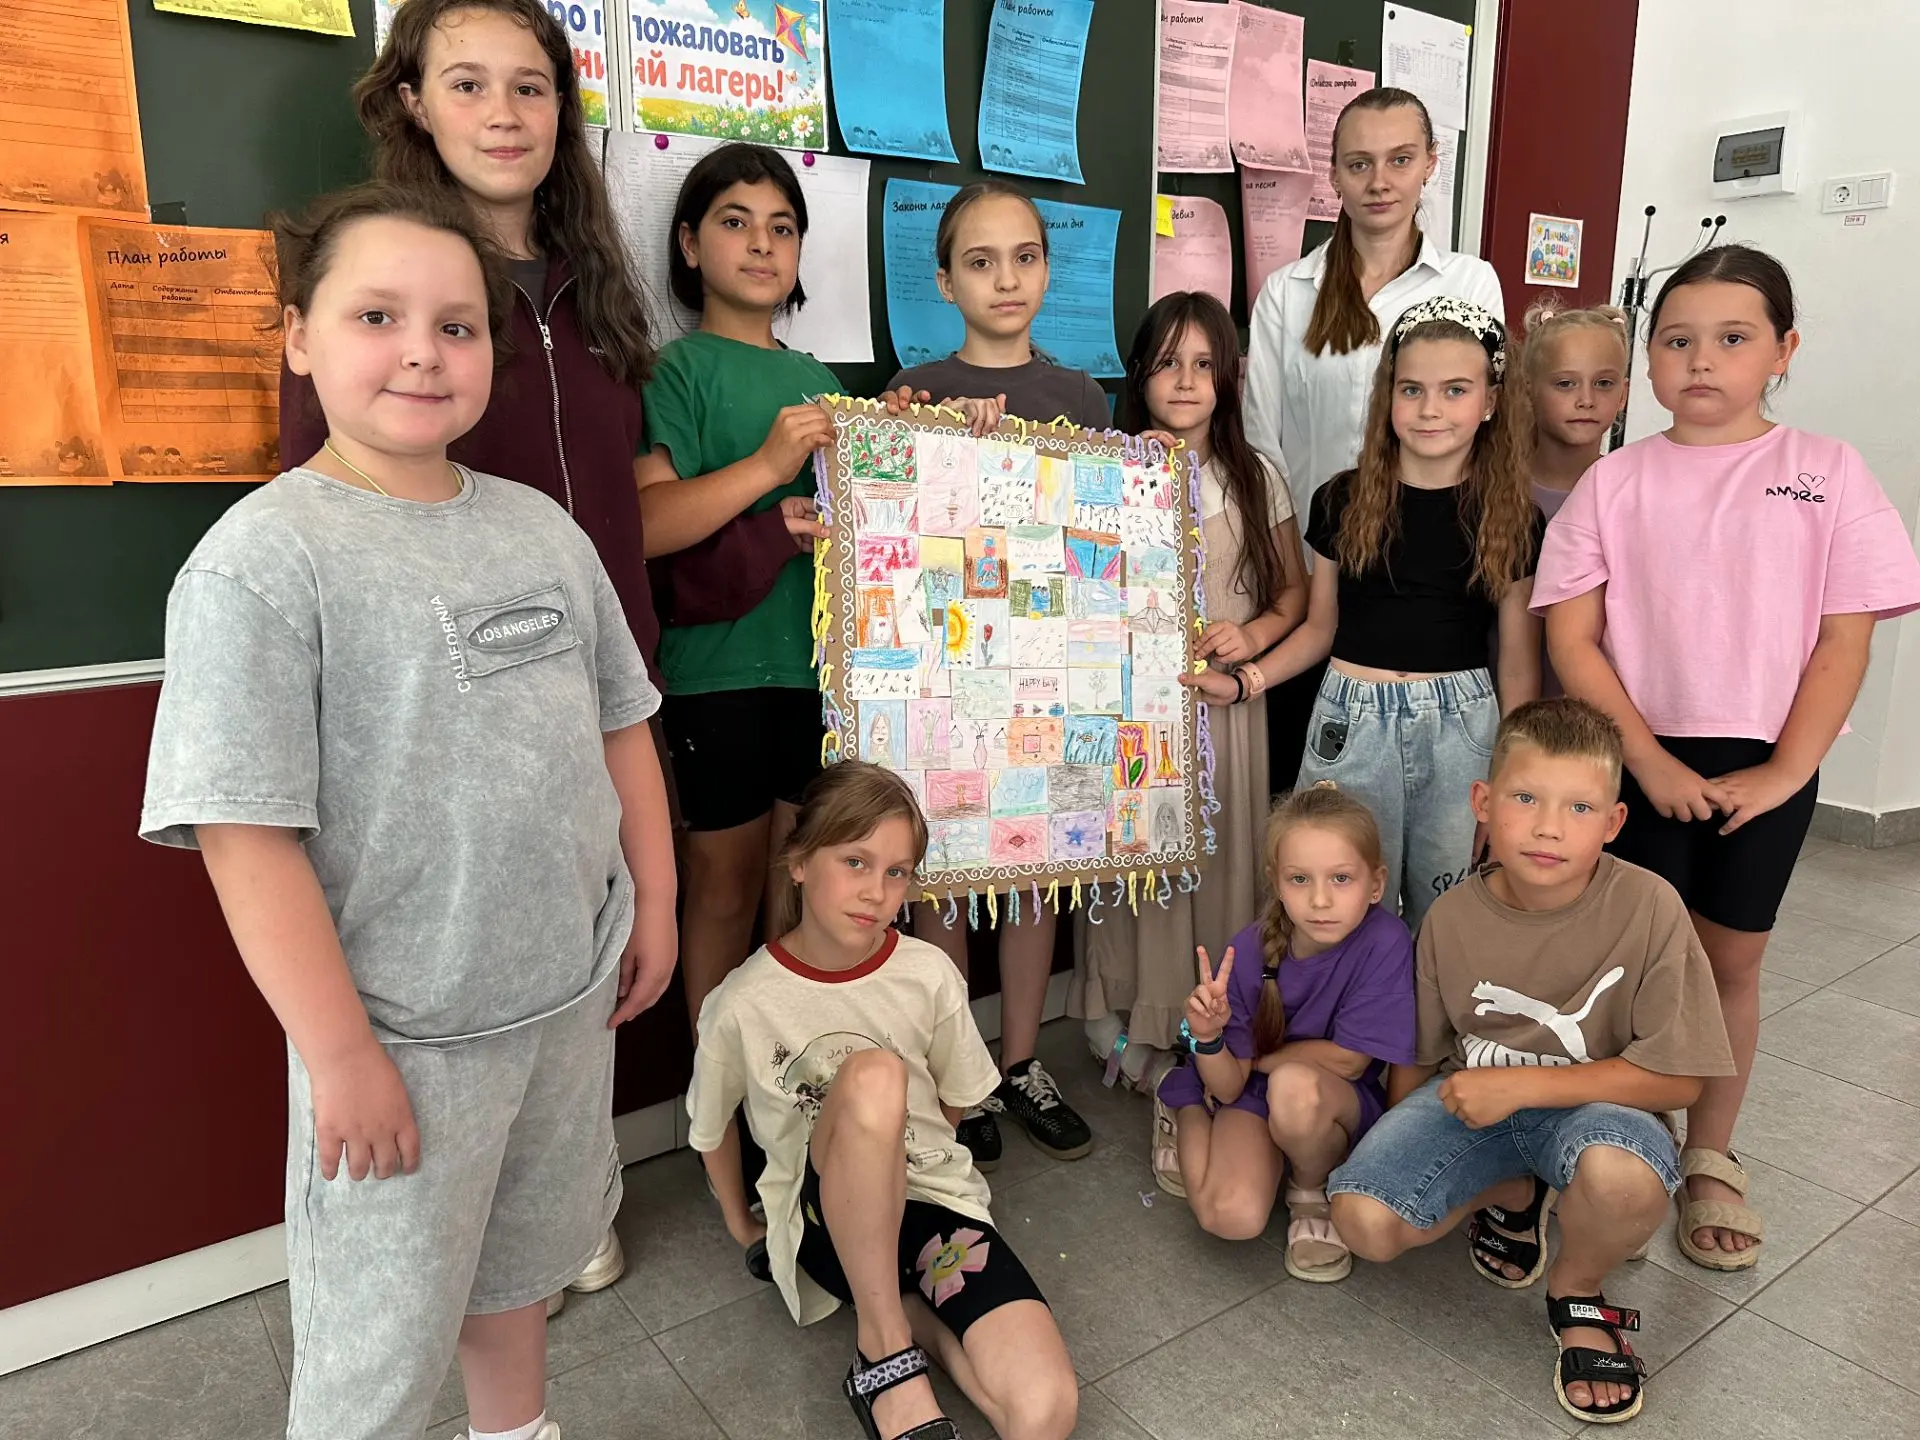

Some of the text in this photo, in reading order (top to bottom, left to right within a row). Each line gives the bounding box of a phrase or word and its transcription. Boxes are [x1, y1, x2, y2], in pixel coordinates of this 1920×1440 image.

[1018, 3, 1053, 16] работы
[1170, 12, 1204, 26] работы
[677, 63, 784, 107] лагерь!
[892, 201, 928, 213] Законы
[1046, 218, 1084, 229] ежим дня
[107, 246, 228, 268] План работы
